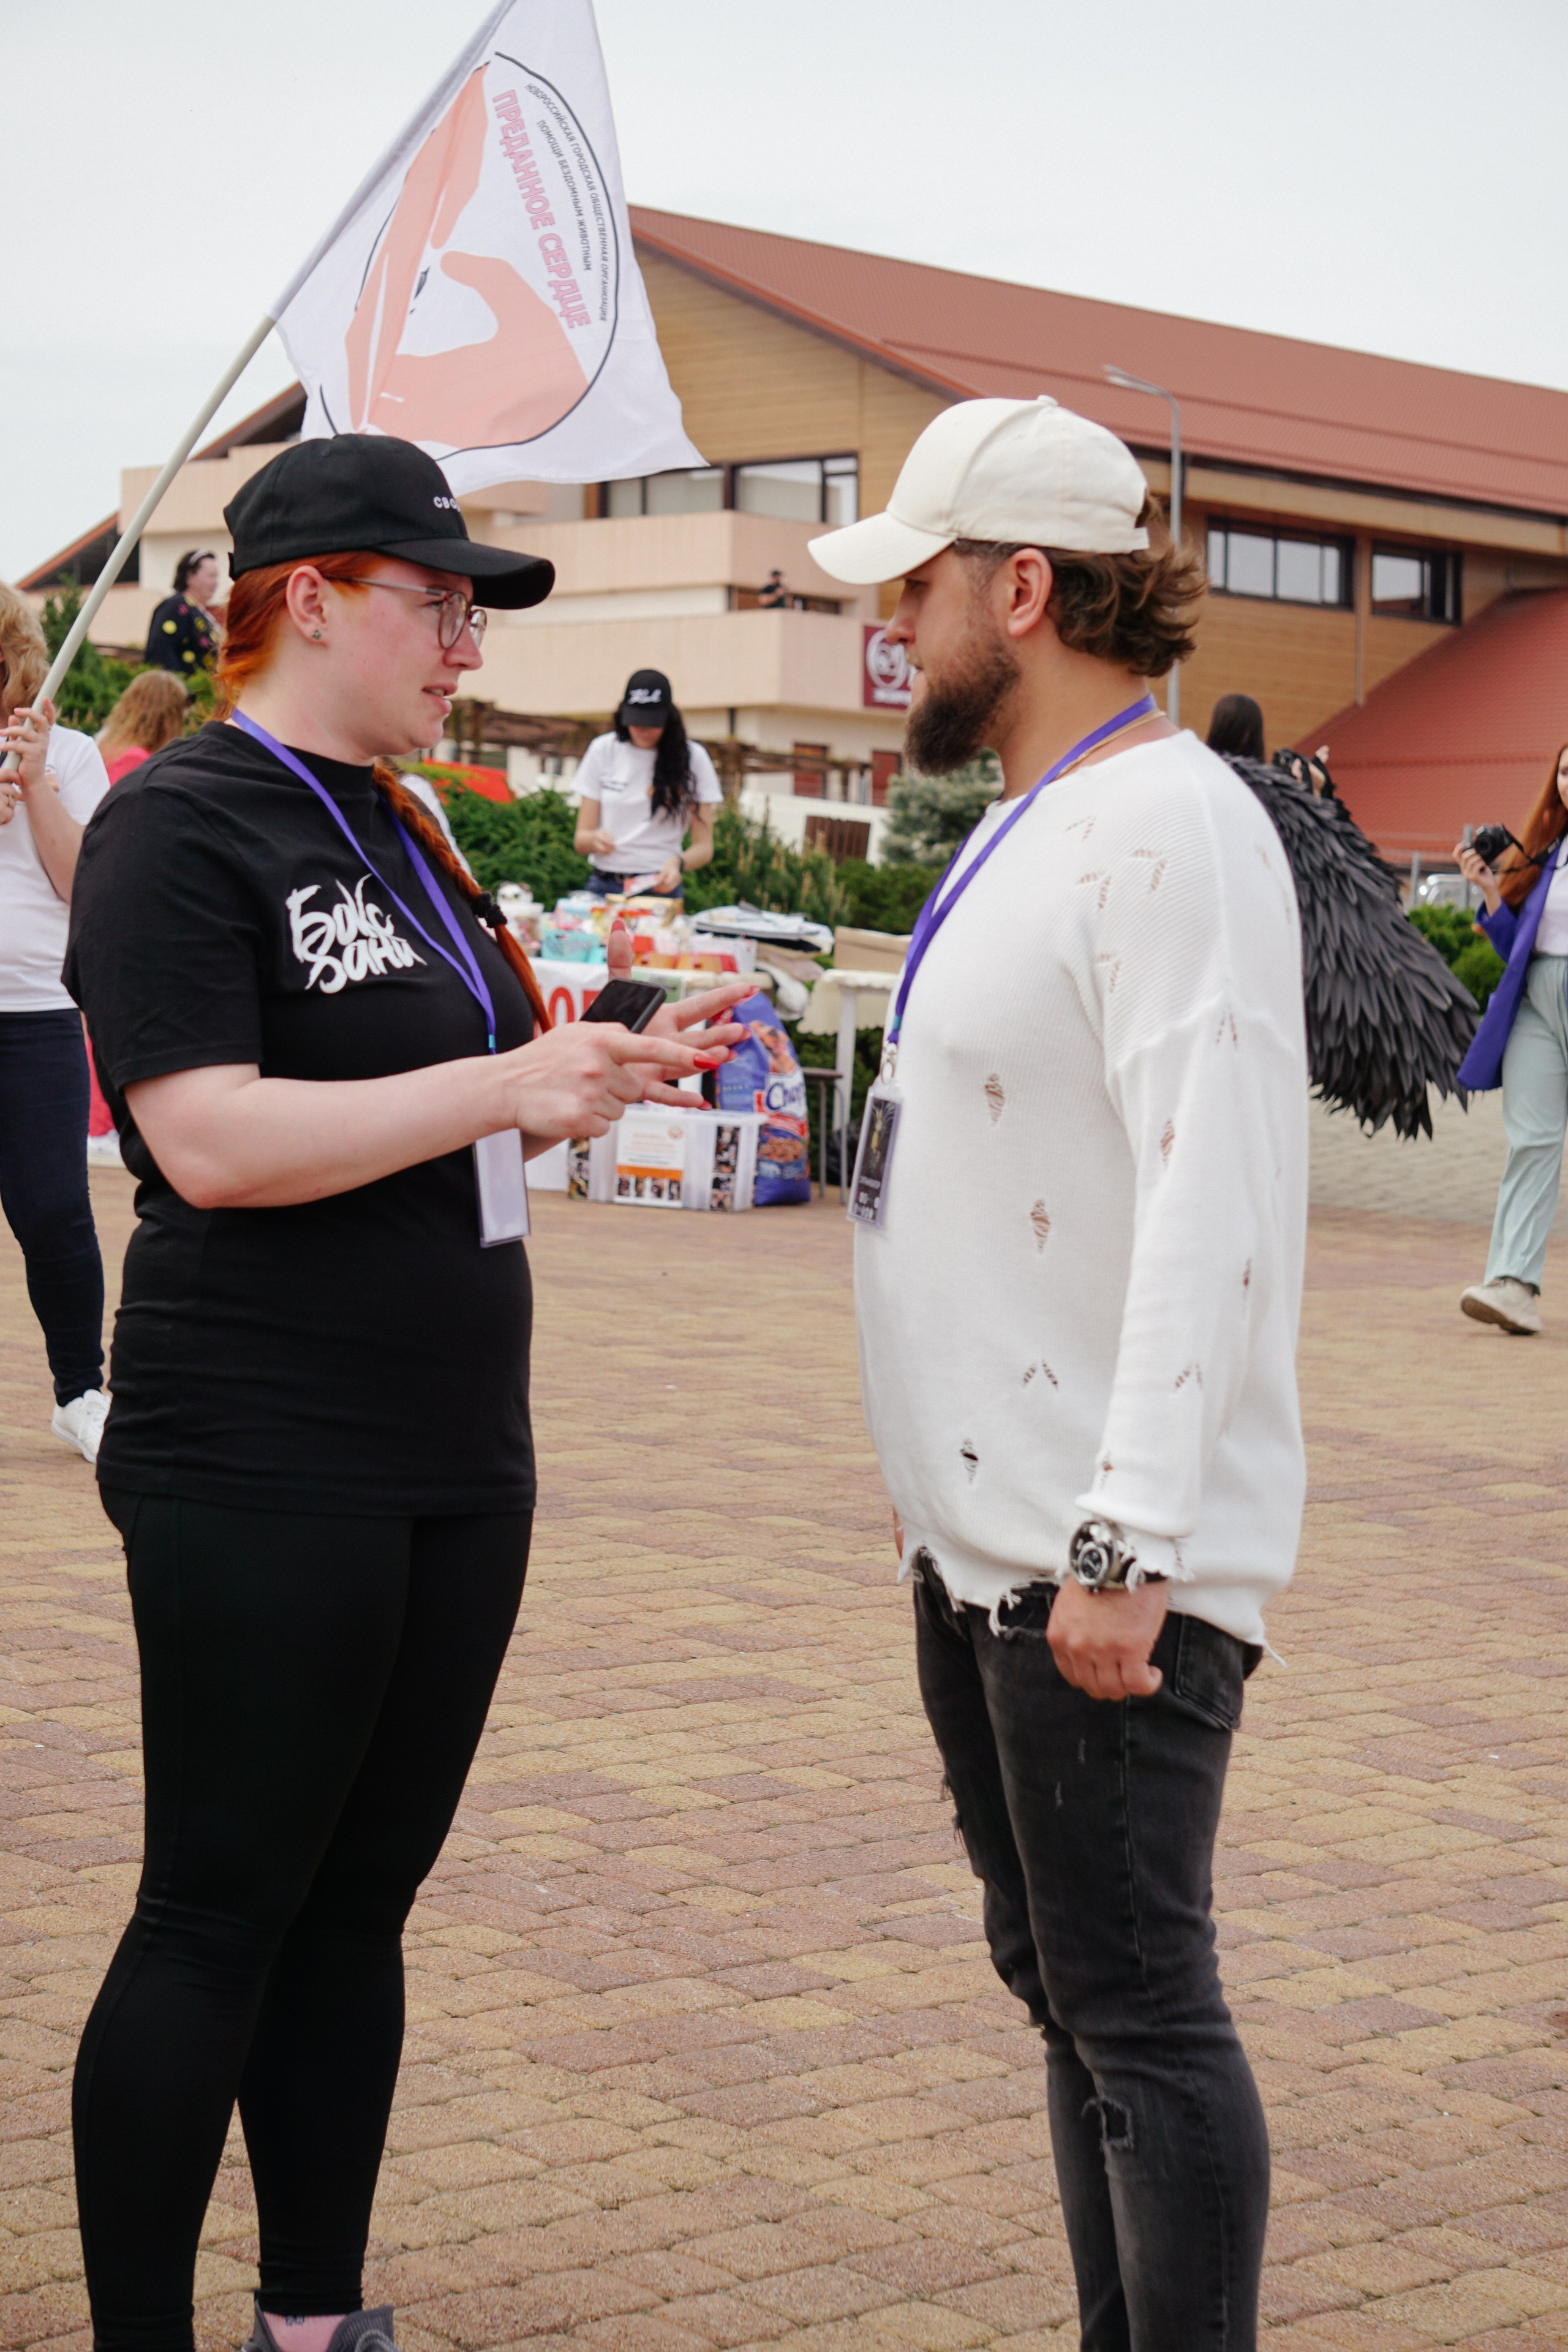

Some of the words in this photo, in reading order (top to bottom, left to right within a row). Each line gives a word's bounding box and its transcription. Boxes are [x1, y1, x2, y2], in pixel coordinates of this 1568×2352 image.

[525, 83, 575, 141] НОВОРОССИЙСКАЯ
[537, 120, 564, 159] ПОМОЩИ
[559, 160, 584, 216] БЕЗДОМНЫМ
[577, 217, 591, 271] ЖИВОТНЫМ
[570, 141, 597, 192] ГОРОДСКАЯ
[493, 90, 556, 230] ПРЕДАННОЕ
[538, 233, 590, 329] СЕРДЦЕ
[590, 192, 609, 262] ОБЩЕСТВЕННАЯ
[599, 263, 609, 321] ОРГАНИЗАЦИЯ
